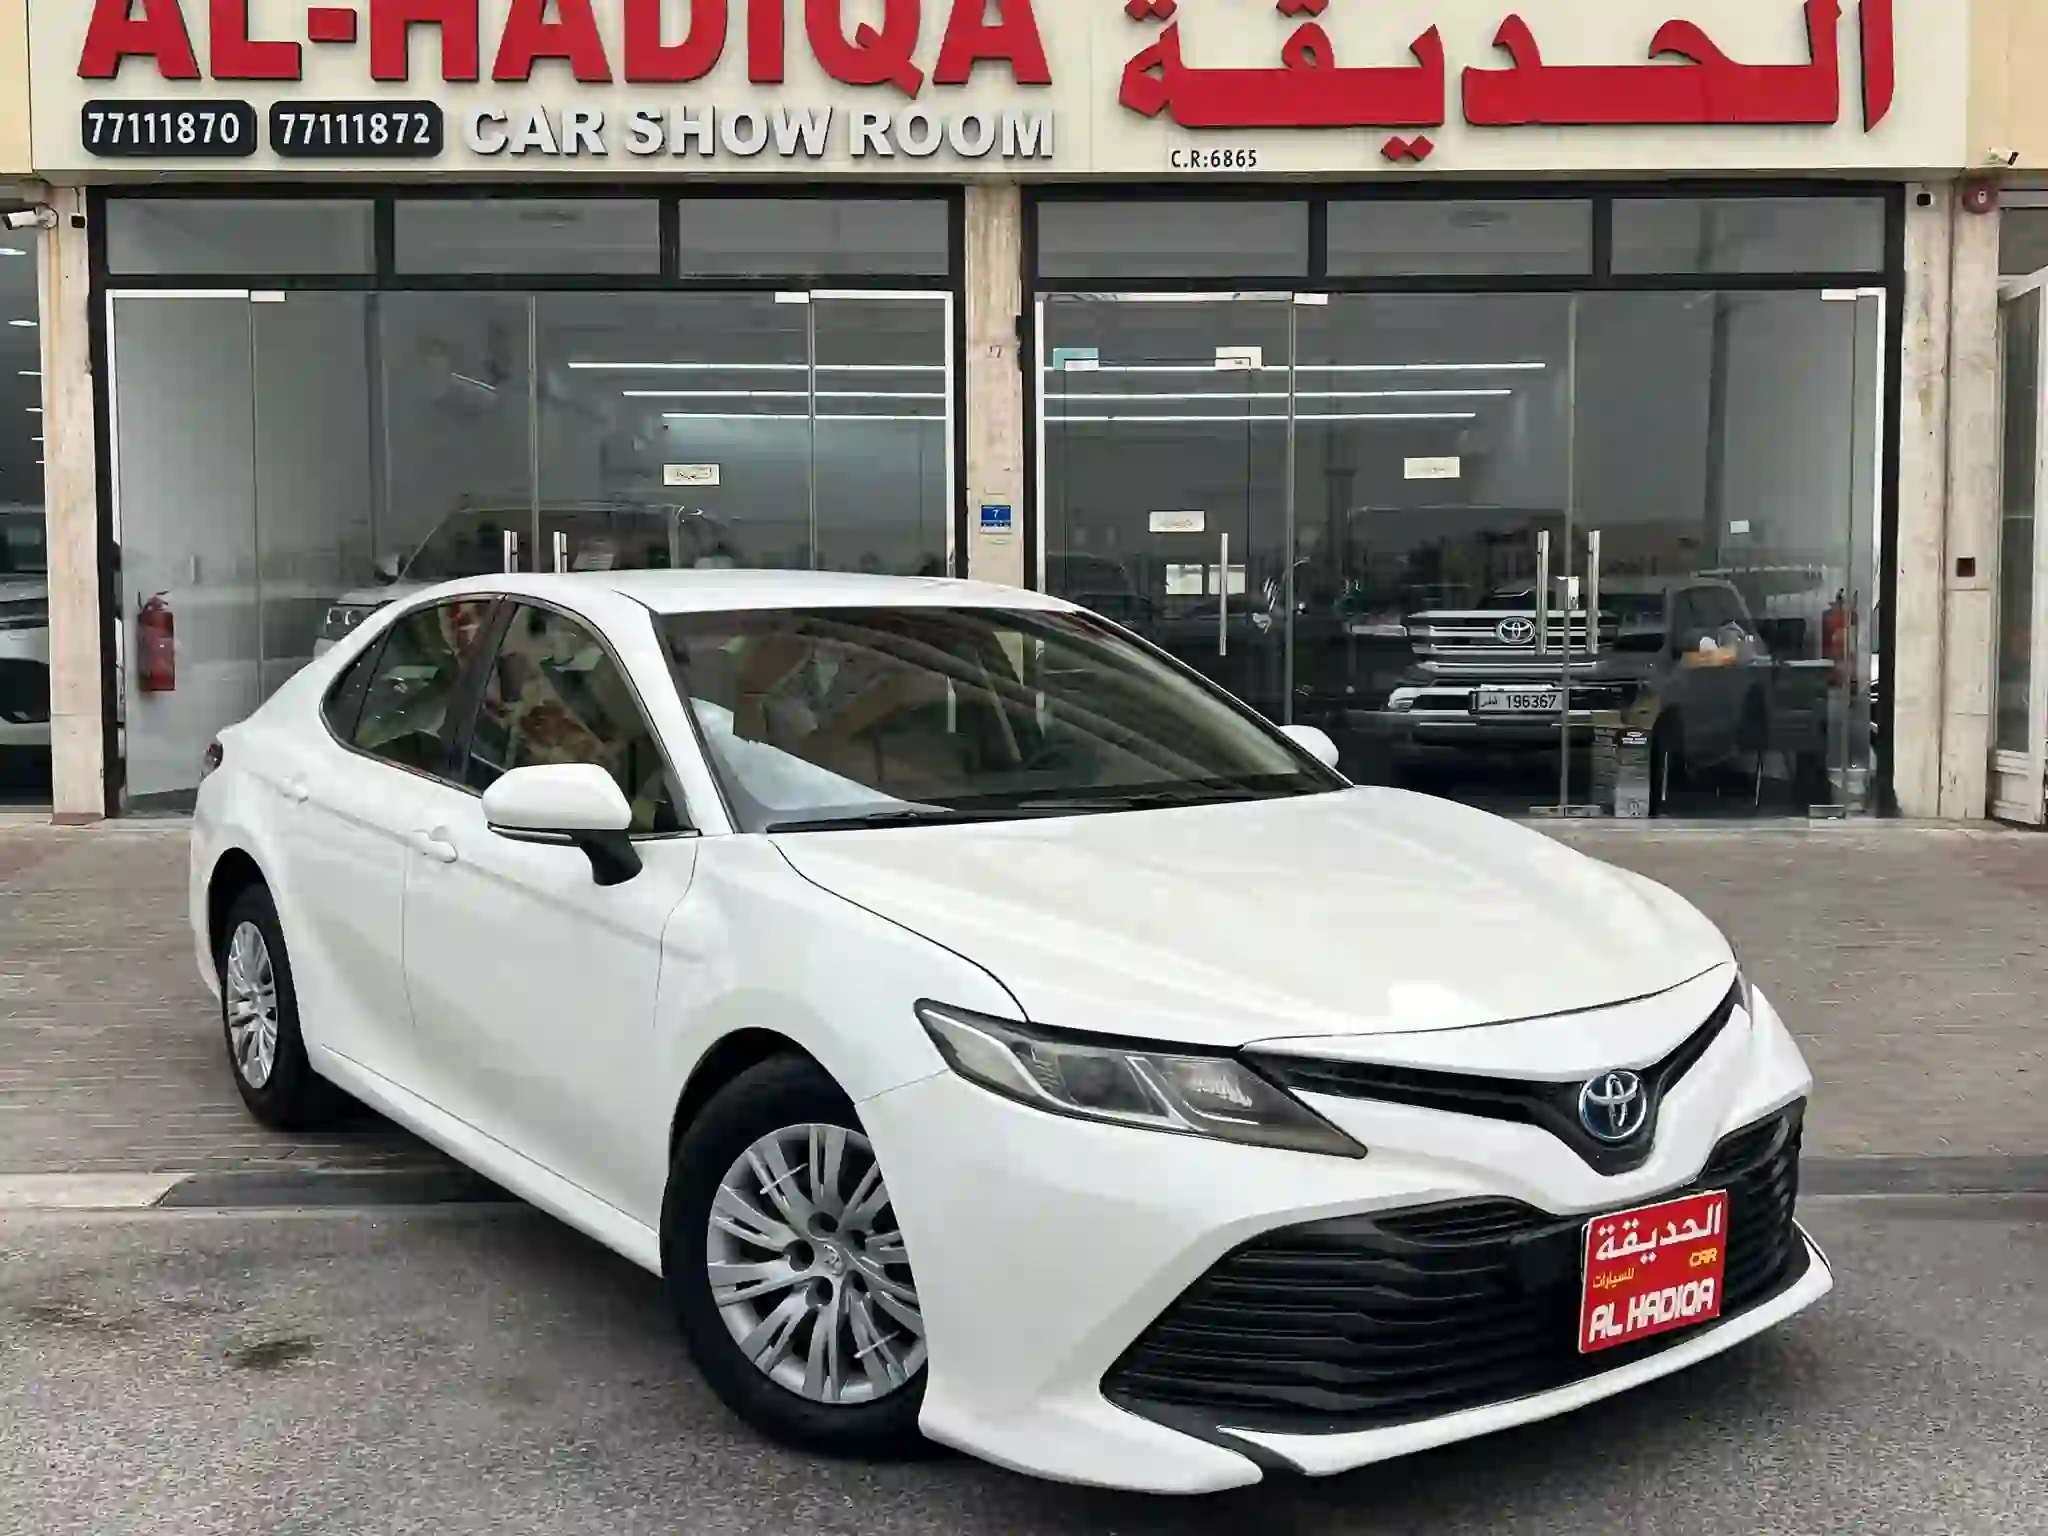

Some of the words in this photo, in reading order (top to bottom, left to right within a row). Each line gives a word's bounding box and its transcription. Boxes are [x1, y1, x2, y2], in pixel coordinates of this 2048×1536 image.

[78, 0, 1052, 96] AL-HADIQA
[1118, 0, 1894, 163] الحديقة
[87, 111, 241, 145] 77111870
[278, 112, 431, 145] 77111872
[466, 103, 607, 157] CAR
[624, 104, 833, 158] SHOW
[849, 105, 1056, 159] ROOM
[1171, 148, 1257, 169] C.R:6865
[1506, 694, 1557, 709] 196367
[1595, 1201, 1722, 1265] الحديقة
[1689, 1247, 1718, 1268] CAR
[1588, 1301, 1624, 1343] AL
